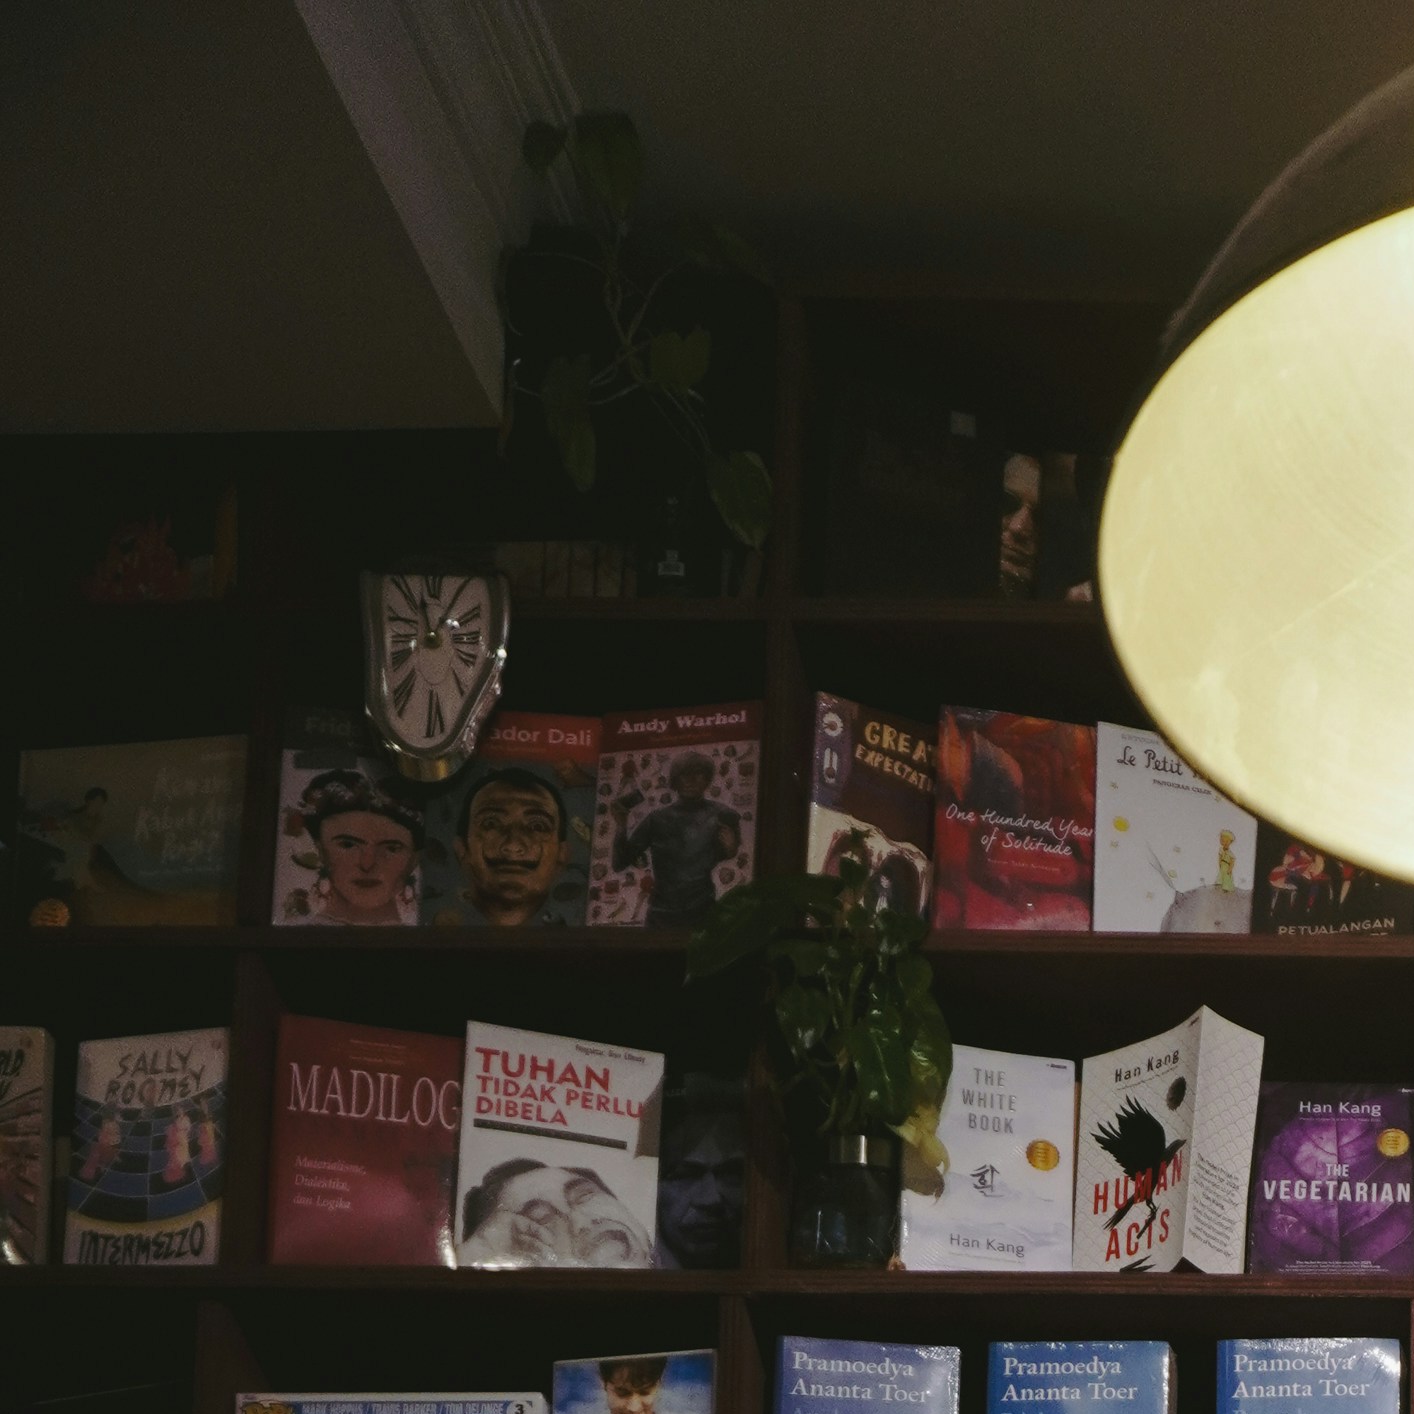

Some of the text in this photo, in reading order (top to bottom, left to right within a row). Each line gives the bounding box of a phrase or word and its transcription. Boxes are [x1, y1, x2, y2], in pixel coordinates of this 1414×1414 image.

[547, 725, 593, 748] Dali
[617, 709, 748, 737] Andy Warhol
[1116, 745, 1185, 778] Le Petit
[946, 803, 1054, 834] One Hundred
[980, 829, 1074, 858] of Solitude
[1276, 916, 1397, 939] PETUALANGAN
[116, 1047, 192, 1079] SALLY
[475, 1046, 611, 1094] TUHAN
[1113, 1049, 1181, 1084] Han Kang
[104, 1065, 206, 1104] ROONEY
[972, 1066, 1007, 1089] THE
[287, 1061, 462, 1130] MADILOG
[475, 1074, 646, 1120] TIDAK PERLU
[960, 1087, 1018, 1113] WHITE
[1299, 1099, 1383, 1118] Han Kang
[475, 1096, 570, 1127] DIBELA
[967, 1111, 1015, 1135] BOOK
[1092, 1148, 1184, 1216] HUMAN
[1325, 1162, 1351, 1178] THE
[1262, 1178, 1412, 1204] VEGETARIAN
[948, 1232, 1026, 1259] Han Kang
[1104, 1206, 1172, 1264] ACTS
[791, 1351, 915, 1379] Pramoedya
[1001, 1354, 1122, 1380] Pramoedya
[1233, 1352, 1356, 1377] Pramoedya
[788, 1378, 931, 1404] Ananta Toer
[1000, 1380, 1139, 1402] Ananta Toer
[1231, 1376, 1371, 1399] Ananta Toer
